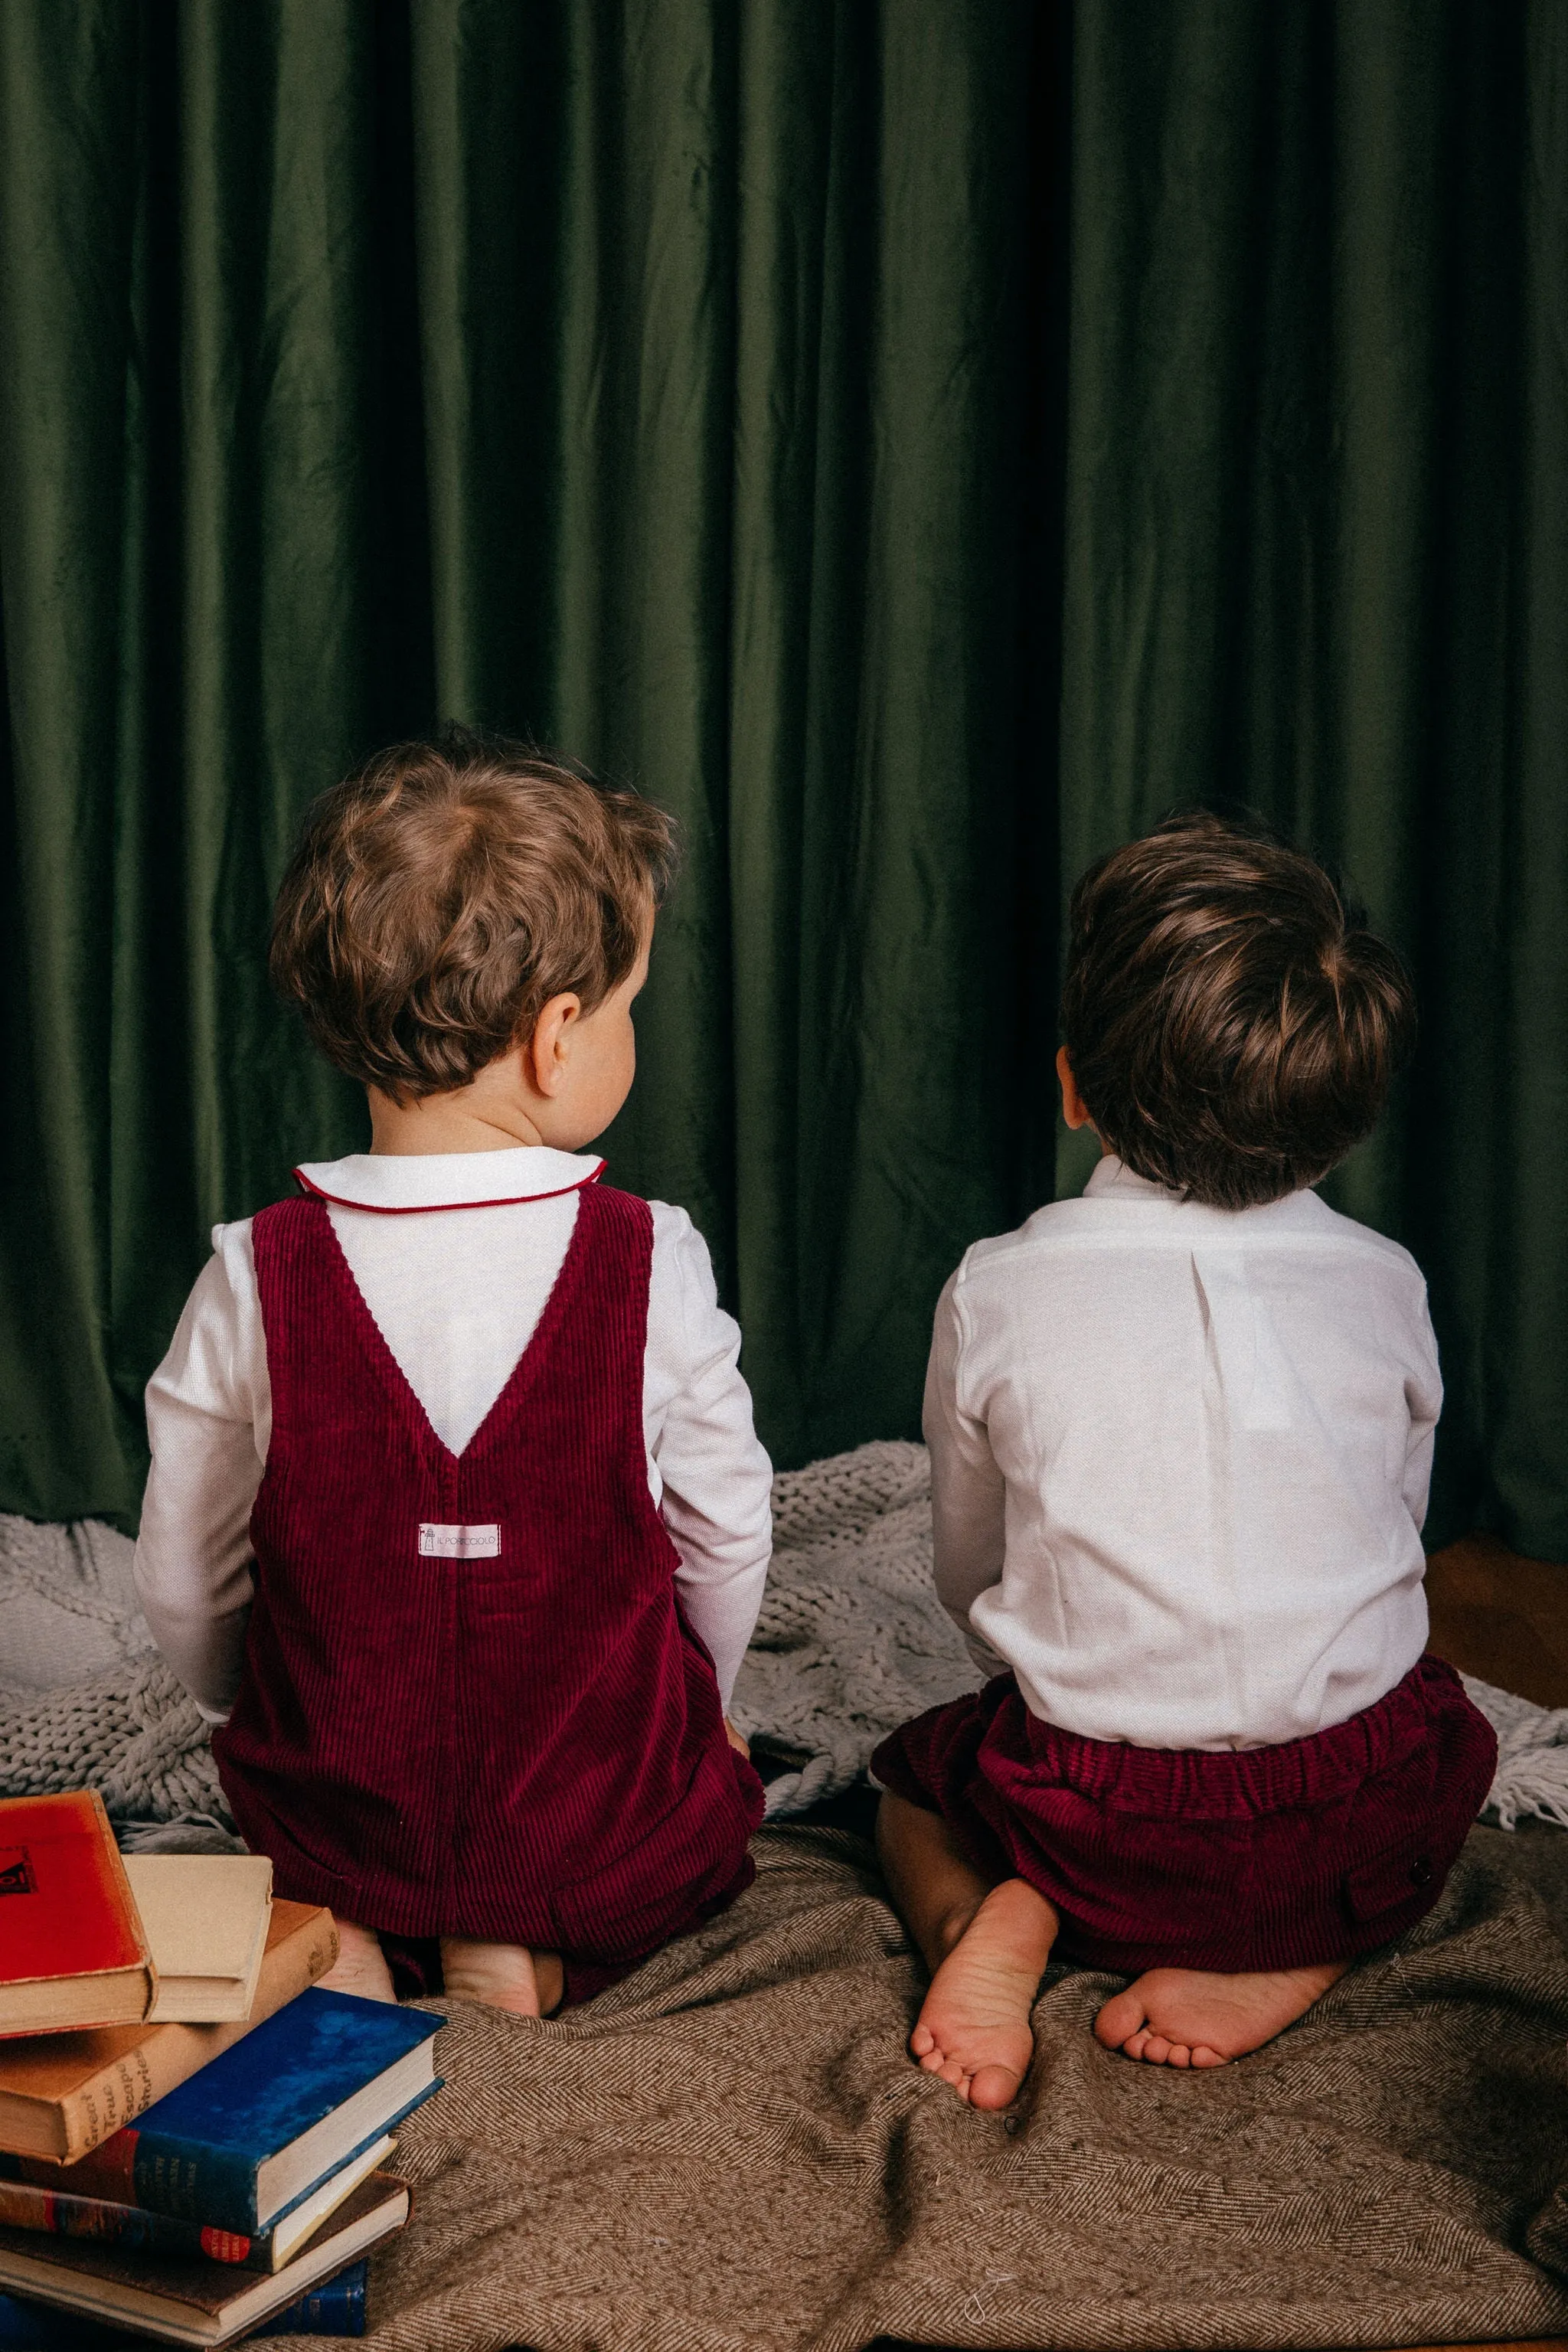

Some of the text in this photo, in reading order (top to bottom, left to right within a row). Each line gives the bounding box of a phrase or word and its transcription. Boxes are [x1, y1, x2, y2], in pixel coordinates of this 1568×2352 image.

[103, 2083, 117, 2133] True
[116, 2063, 134, 2125] Escape
[133, 2050, 152, 2112] Stories
[80, 2094, 99, 2148] Great
